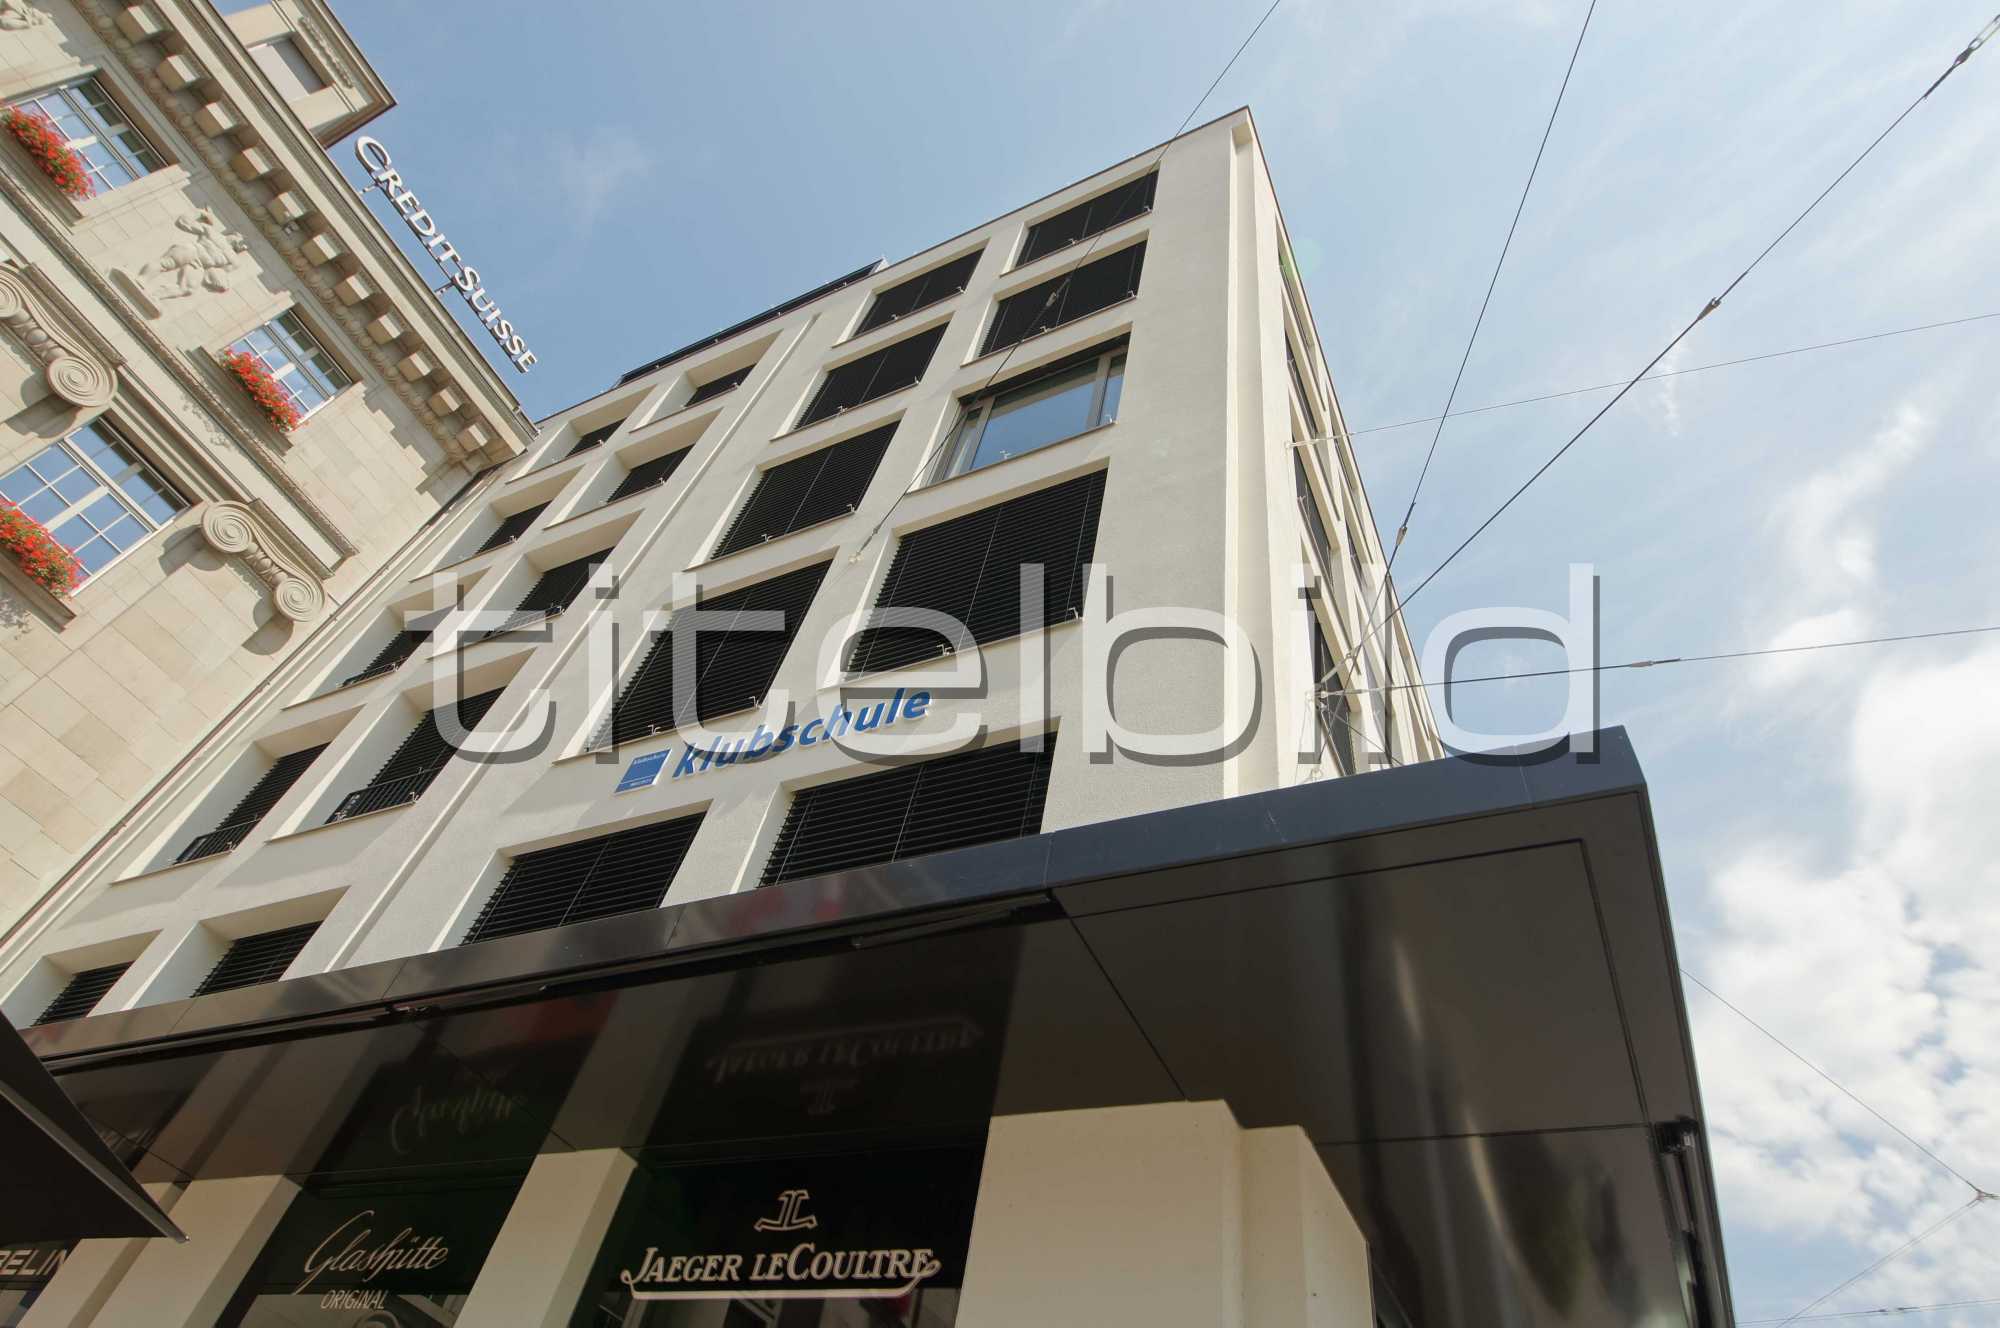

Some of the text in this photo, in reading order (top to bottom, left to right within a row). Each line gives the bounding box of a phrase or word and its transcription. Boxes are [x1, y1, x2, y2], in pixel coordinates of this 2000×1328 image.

[354, 135, 538, 375] CREDIT SUISSE
[671, 686, 933, 780] klubschule
[291, 1209, 450, 1296] Glashütte
[620, 1247, 743, 1285] JAEGER
[319, 1289, 391, 1310] ORIGINAL
